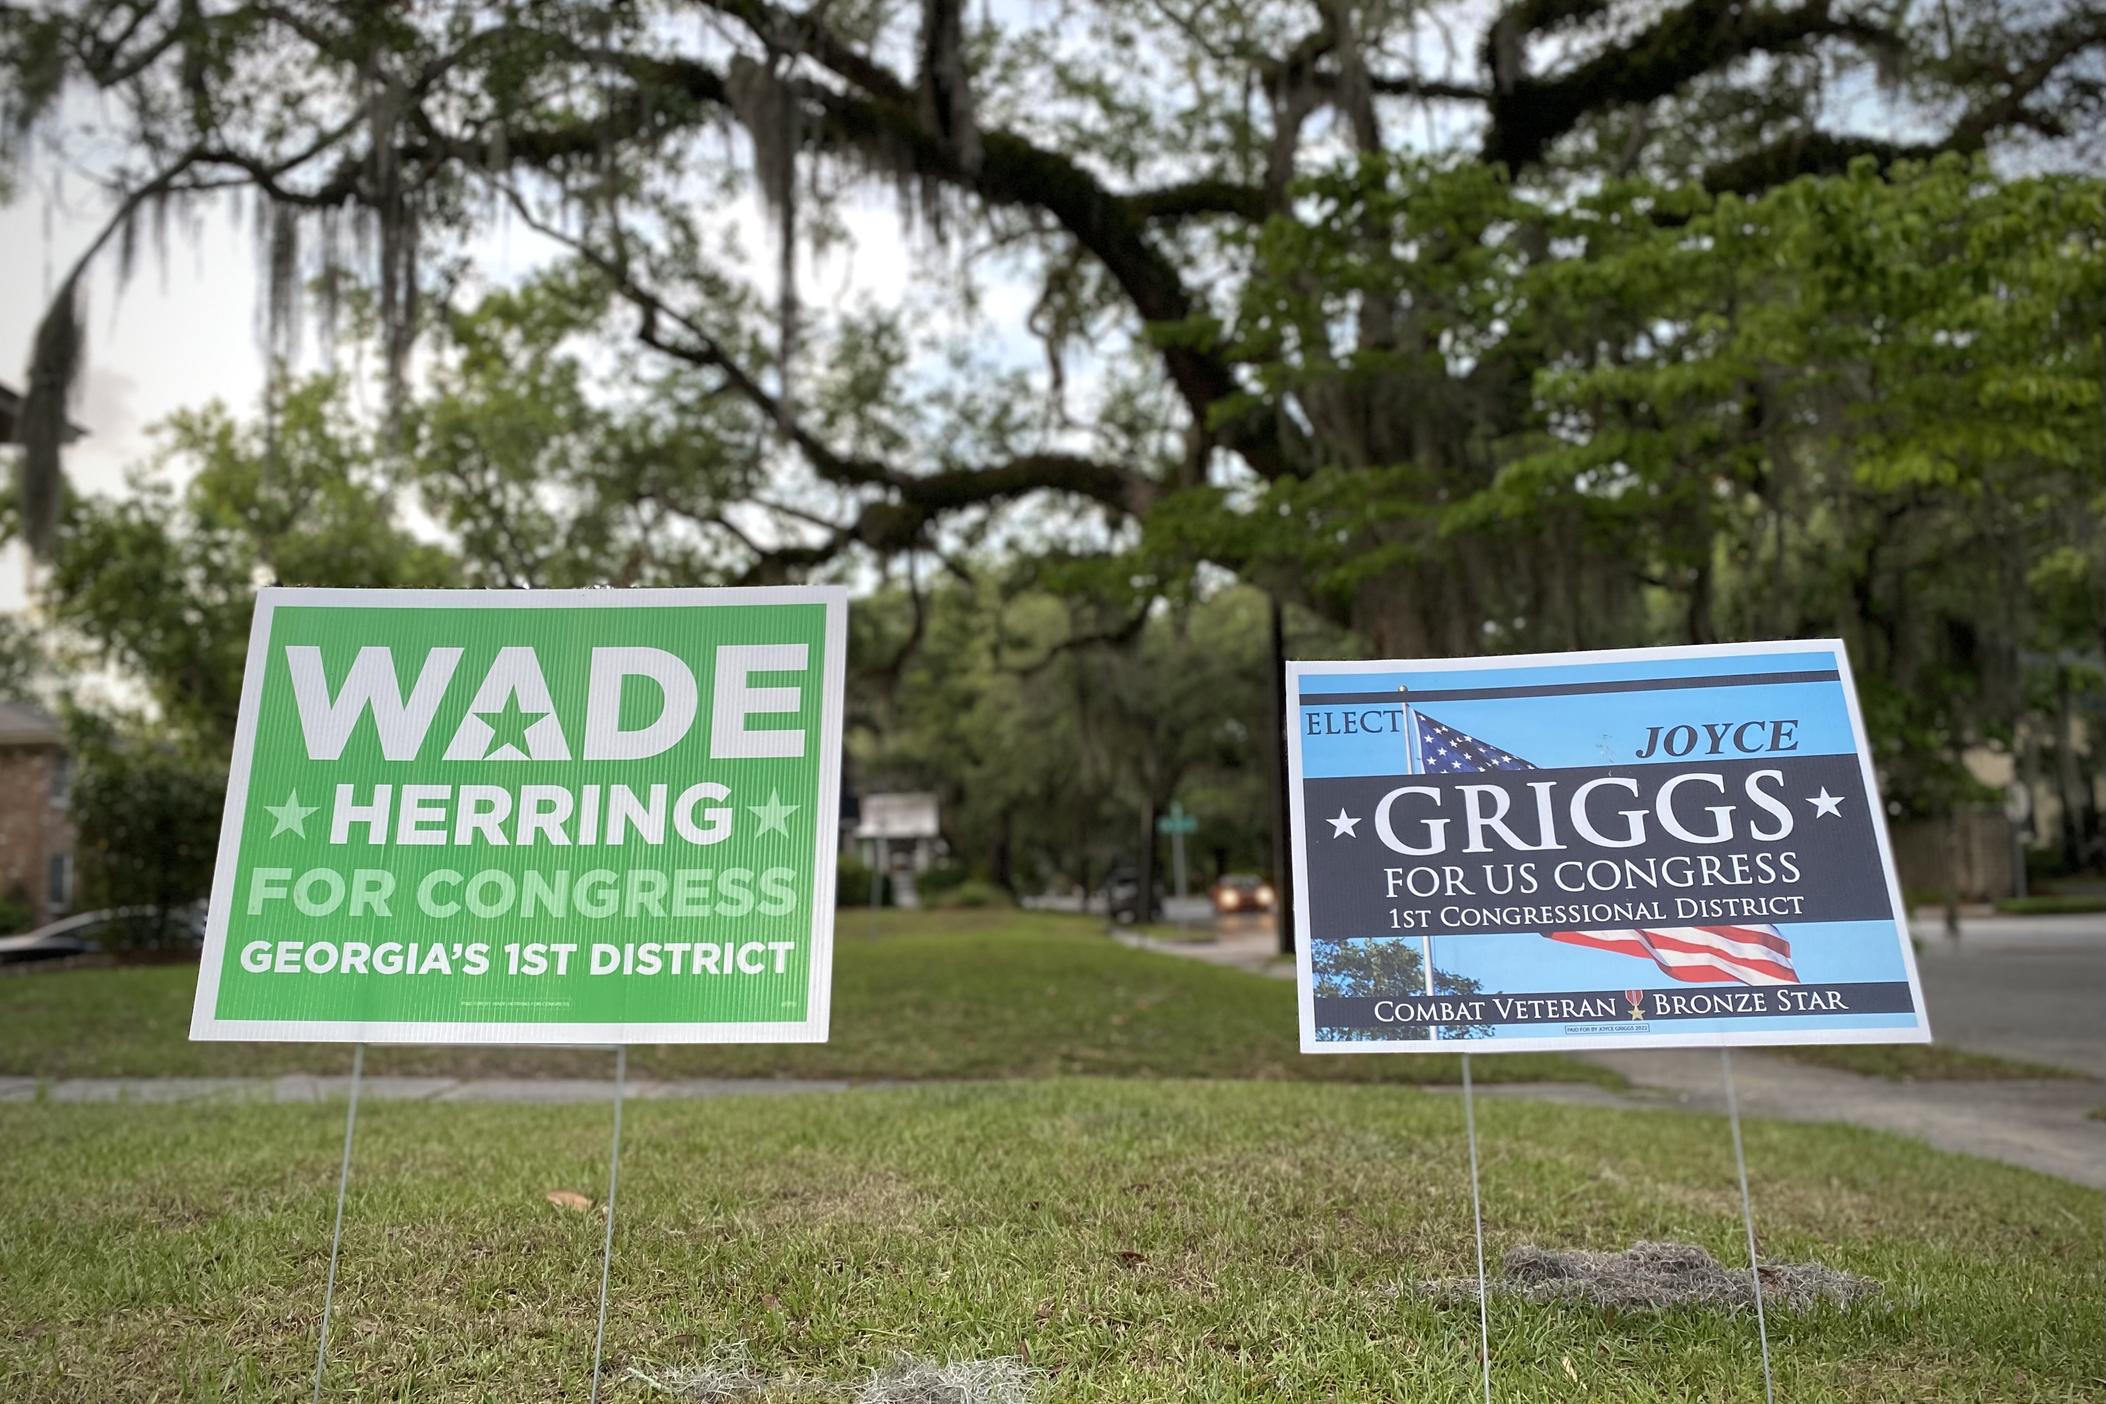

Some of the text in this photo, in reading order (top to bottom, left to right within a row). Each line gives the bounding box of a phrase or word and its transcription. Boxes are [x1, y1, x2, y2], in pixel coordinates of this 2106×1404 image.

[285, 644, 809, 761] WADE
[1306, 710, 1404, 736] ELECT
[1635, 719, 1800, 759] JOYCE
[330, 782, 734, 846] HERRING
[1374, 770, 1795, 856] GRIGGS
[246, 867, 798, 919] FOR CONGRESS
[1384, 851, 1801, 898] FOR US CONGRESS
[1389, 908, 1431, 929] 1ST
[240, 940, 796, 975] GEORGIA’S 1ST DISTRICT
